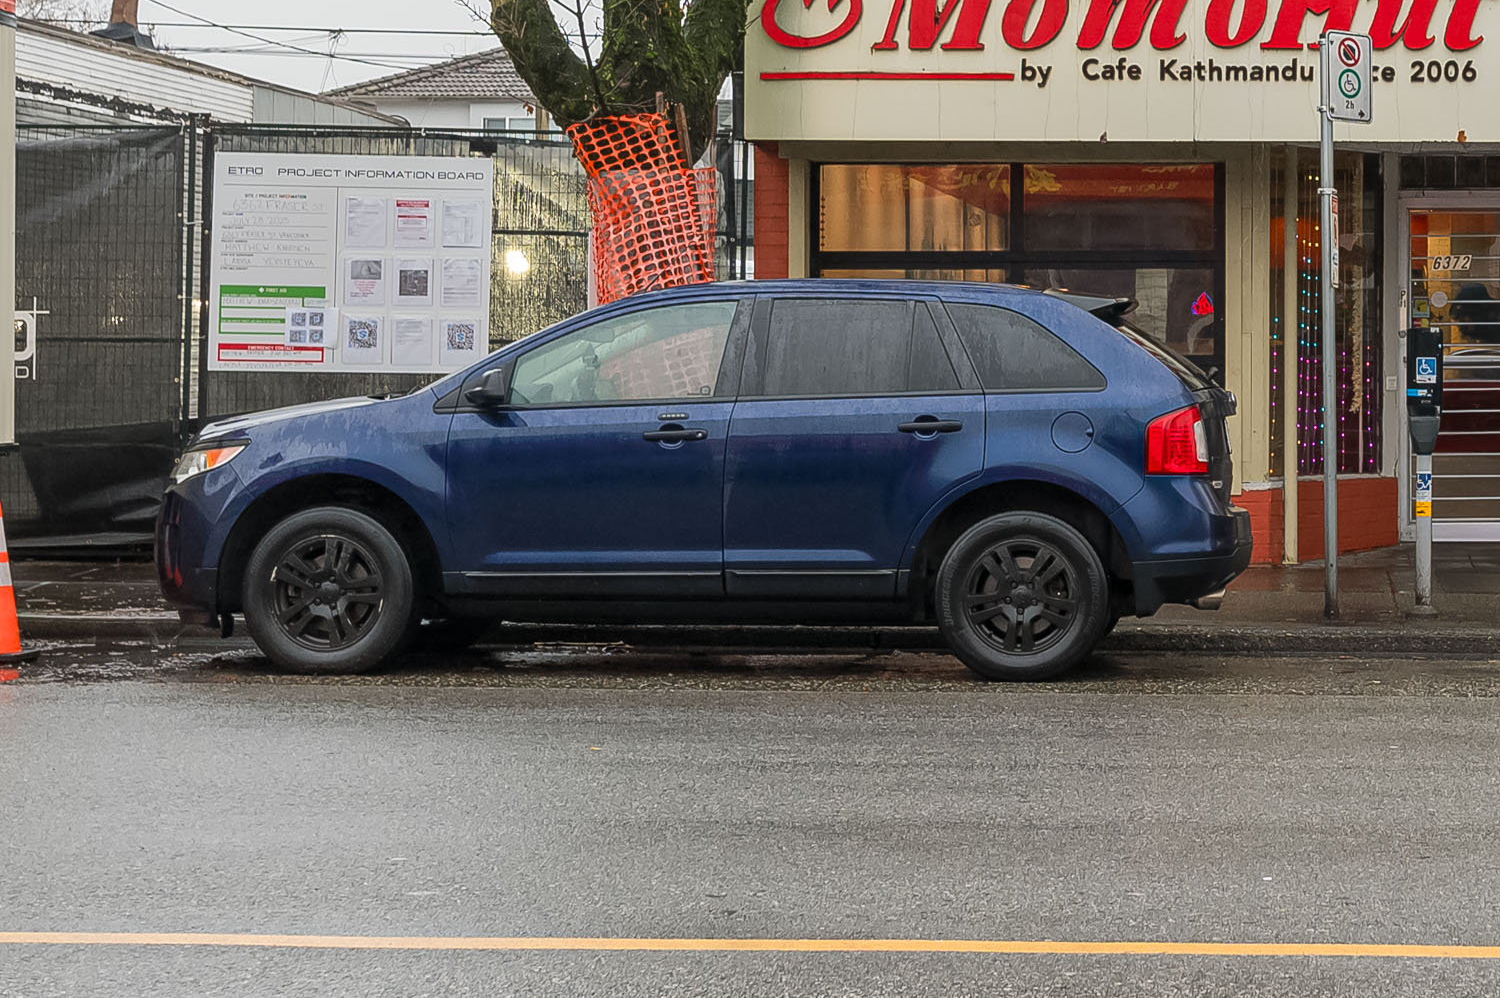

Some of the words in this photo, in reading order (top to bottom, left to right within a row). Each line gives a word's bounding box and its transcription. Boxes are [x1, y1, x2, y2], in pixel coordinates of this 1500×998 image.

[1021, 58, 1052, 87] by
[1082, 58, 1142, 82] Cafe
[1160, 58, 1314, 82] Kathmandu
[1411, 60, 1477, 83] 2006
[228, 166, 263, 175] ETRO
[277, 168, 342, 177] PROJECT
[345, 170, 435, 179] INFORMATION
[437, 171, 484, 180] BOARD
[1433, 256, 1470, 270] 6372
